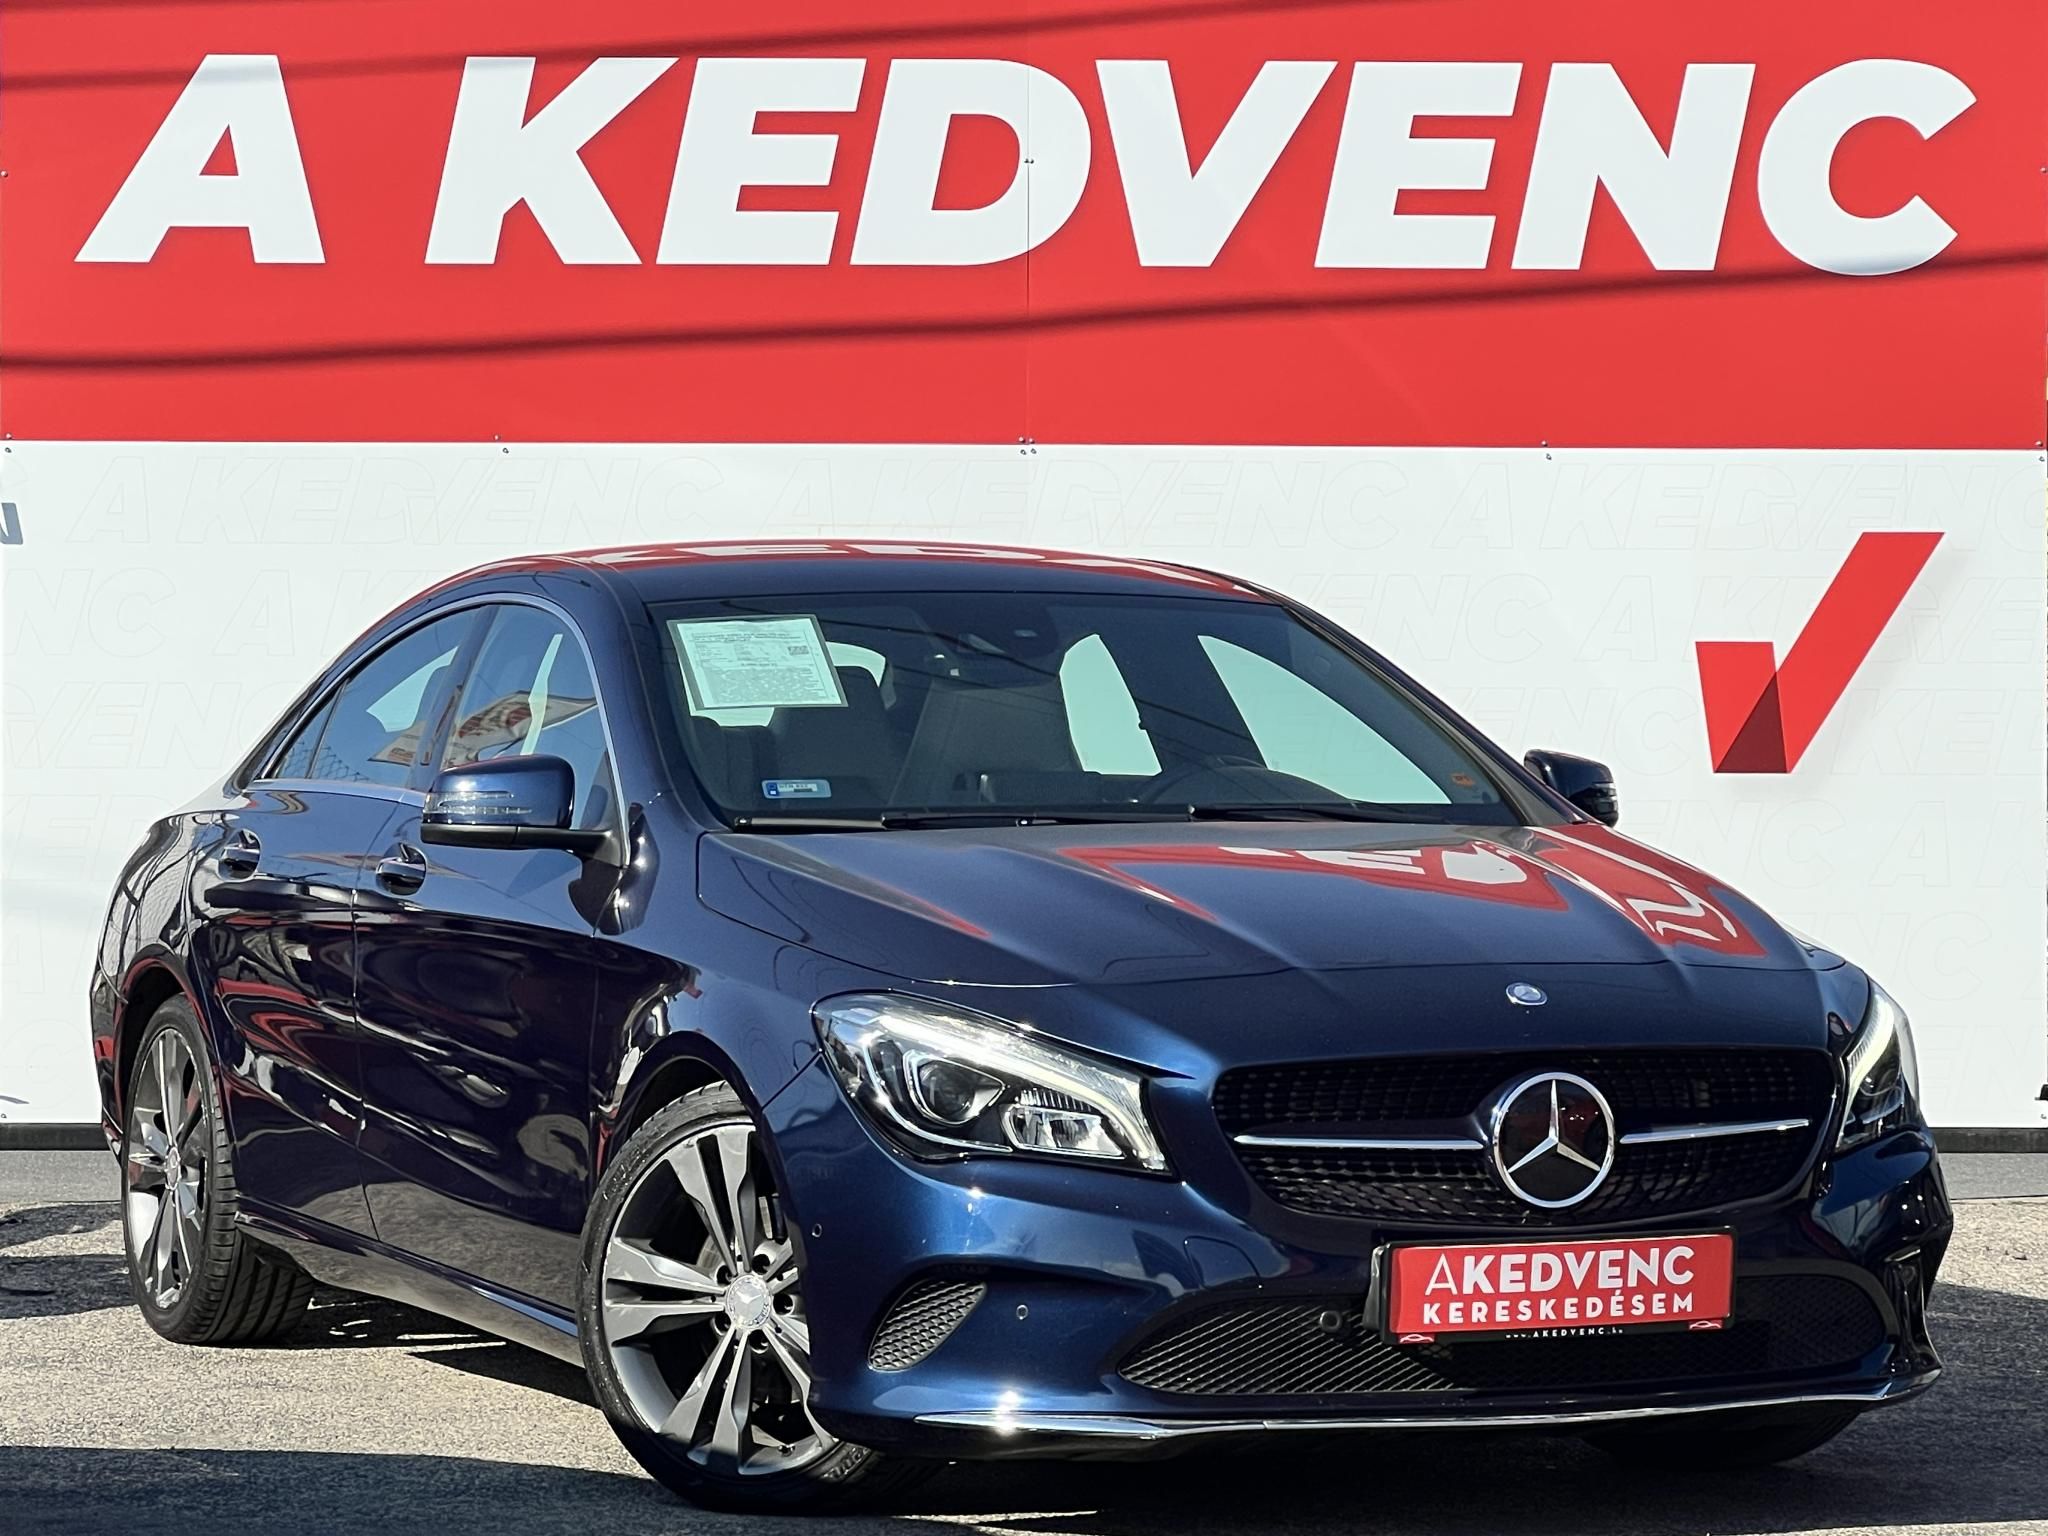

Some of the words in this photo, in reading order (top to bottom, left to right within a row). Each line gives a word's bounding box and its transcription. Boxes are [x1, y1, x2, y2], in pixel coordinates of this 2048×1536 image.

[74, 54, 326, 264] A
[425, 57, 1977, 276] KEDVENC
[1424, 1245, 1695, 1296] AKEDVENC
[1423, 1290, 1693, 1325] KERESKEDÉSEM
